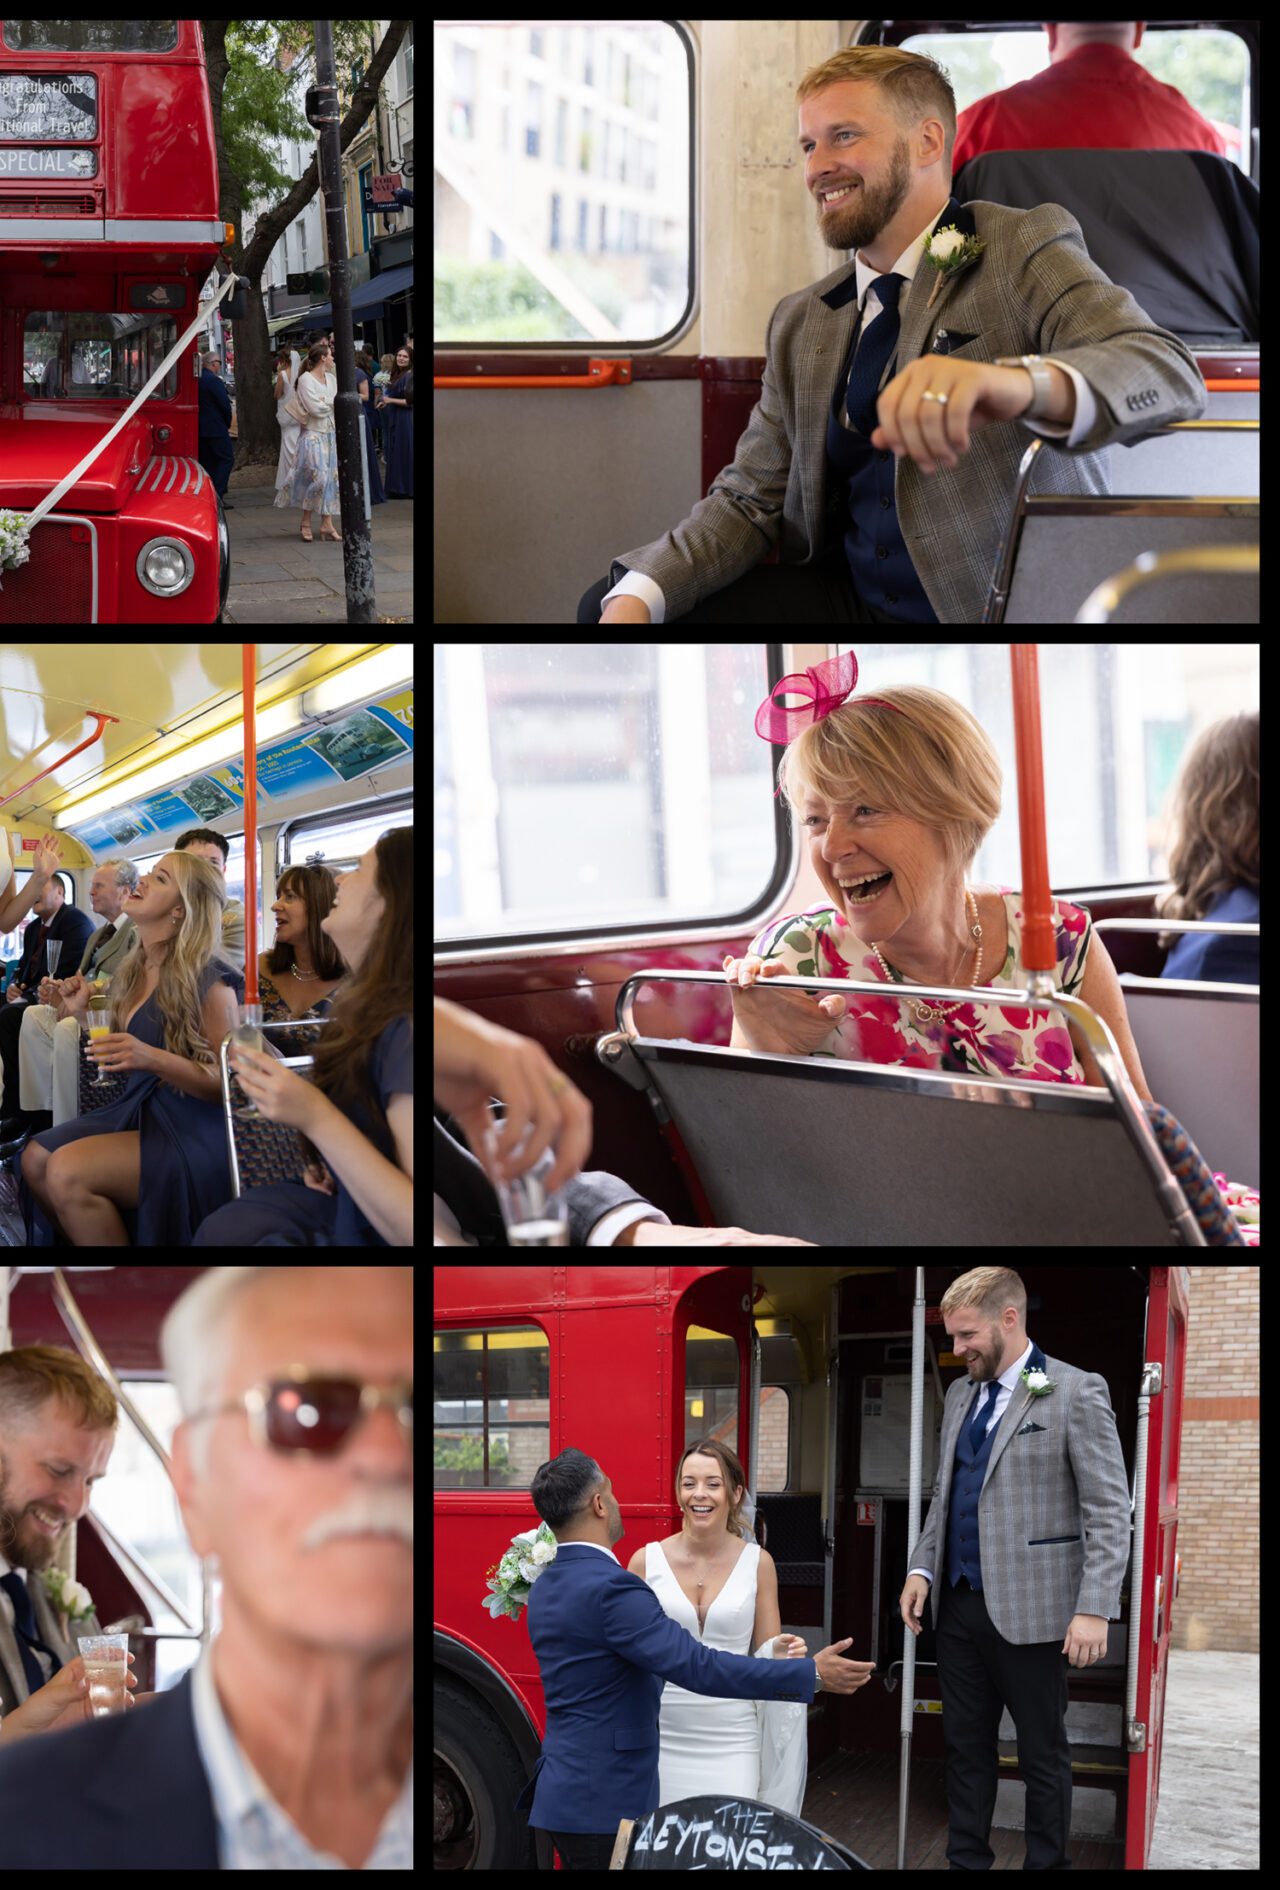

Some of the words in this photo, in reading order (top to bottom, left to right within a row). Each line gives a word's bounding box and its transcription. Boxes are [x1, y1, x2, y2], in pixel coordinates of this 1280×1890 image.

[15, 98, 47, 113] From
[50, 117, 90, 133] Travel
[715, 1802, 774, 1835] THE
